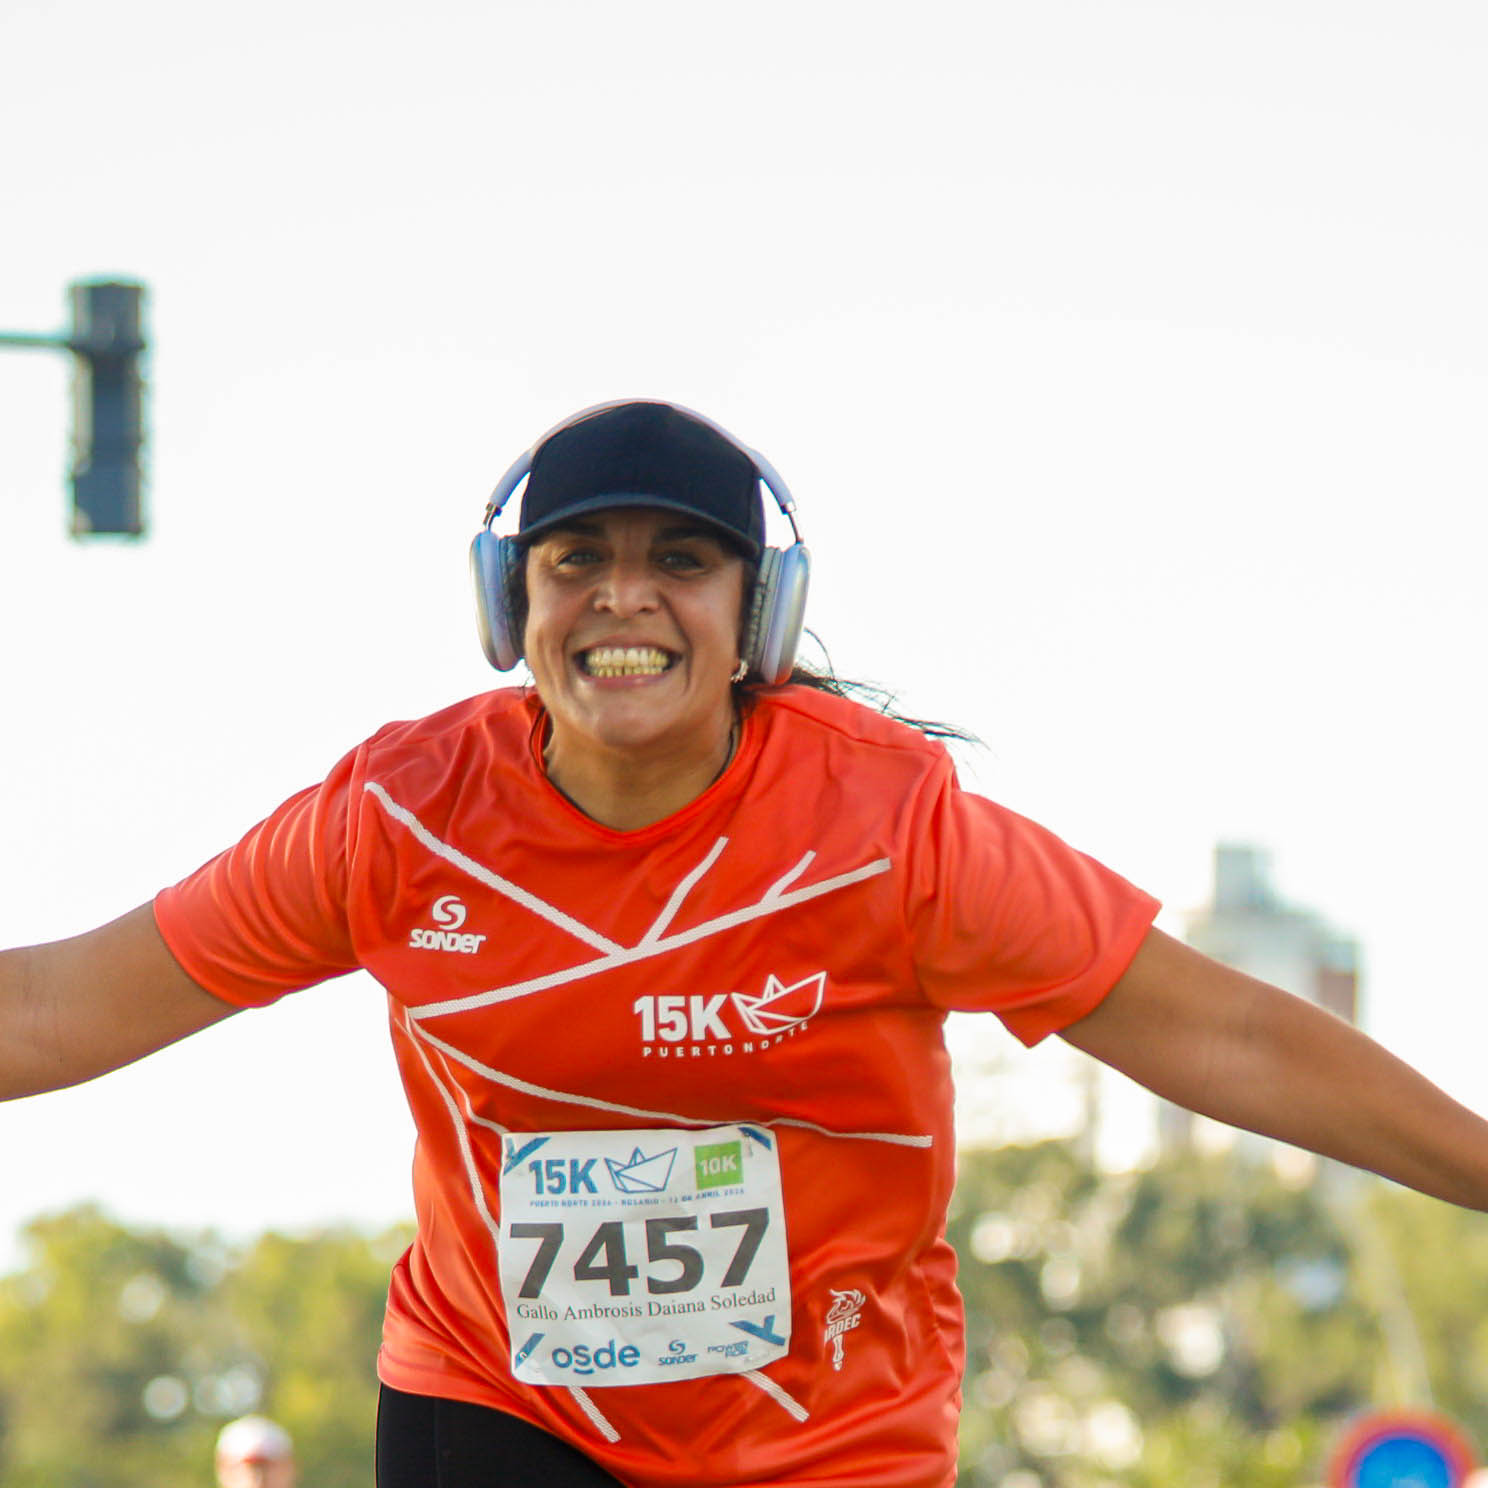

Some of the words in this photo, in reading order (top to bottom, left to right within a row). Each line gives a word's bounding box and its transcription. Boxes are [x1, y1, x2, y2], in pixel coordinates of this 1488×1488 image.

[633, 993, 732, 1042] 15K
[643, 1044, 734, 1057] PUERTO
[743, 1021, 809, 1053] NORTE
[528, 1158, 599, 1195] 15K
[698, 1155, 738, 1178] 10K
[509, 1207, 770, 1299] 7457
[516, 1303, 559, 1321] Gallo
[564, 1302, 643, 1320] Ambrosis
[647, 1299, 706, 1317] Daiana
[710, 1287, 776, 1311] Soledad
[551, 1339, 641, 1371] osde
